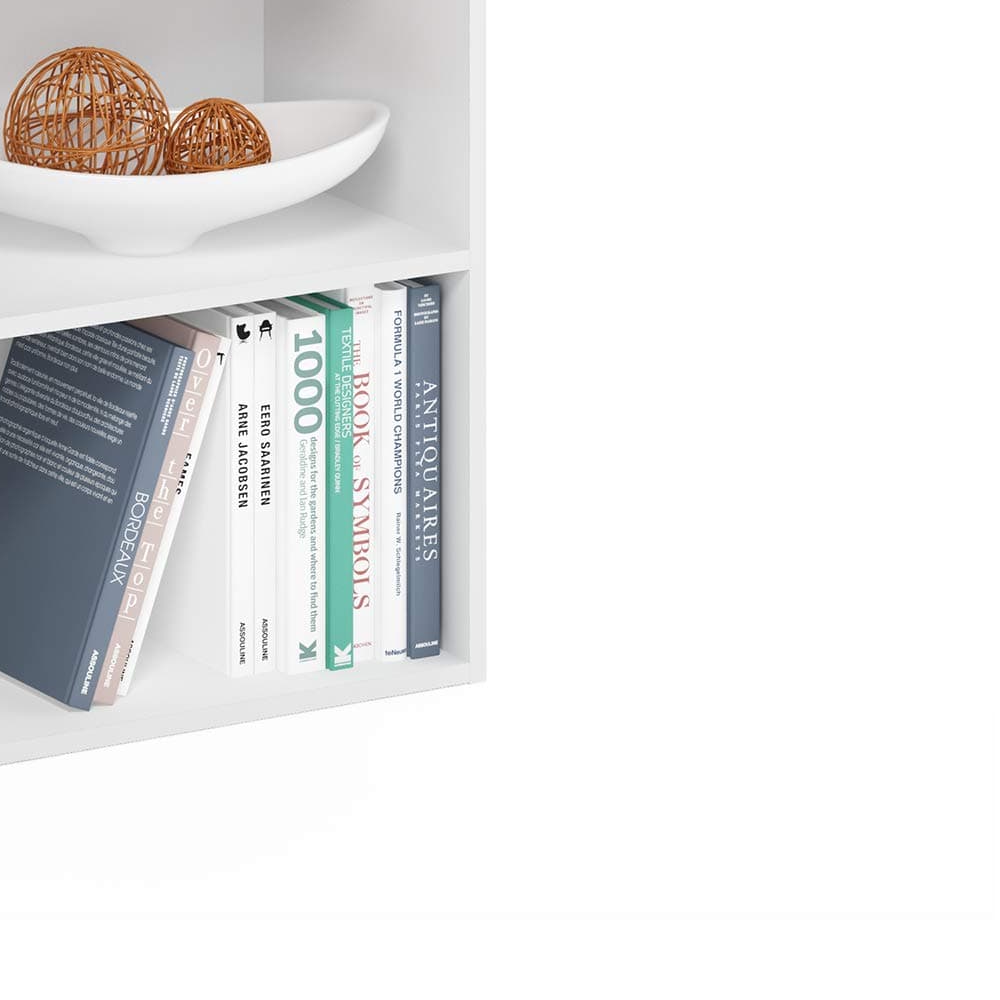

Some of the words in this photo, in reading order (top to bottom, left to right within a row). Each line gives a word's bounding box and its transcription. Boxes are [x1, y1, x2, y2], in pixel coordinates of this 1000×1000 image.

[342, 326, 352, 372] TEXTILE
[394, 310, 402, 367] FORMULA
[180, 348, 212, 432] Over
[294, 330, 322, 434] 1000
[334, 373, 340, 382] AT
[238, 404, 248, 436] ARNE
[260, 404, 270, 436] EERO
[342, 375, 352, 439] DESIGNERS
[353, 373, 370, 447] BOOK
[394, 379, 402, 422] WORLD
[260, 442, 270, 506] SAARINEN
[300, 439, 308, 478] Geraldine
[309, 436, 318, 469] designs
[353, 455, 360, 470] OF
[394, 424, 402, 494] CHAMPIONS
[421, 380, 438, 561] ANTIQUAIRES
[154, 459, 176, 520] the
[238, 442, 248, 508] JACOBSEN
[300, 480, 308, 495] and
[310, 471, 318, 482] for
[310, 484, 318, 498] the
[298, 512, 308, 538] Rudge
[308, 500, 318, 534] gardens
[110, 492, 150, 586] BORDEAUX
[353, 476, 370, 610] SYMBOLS
[310, 582, 317, 590] to
[310, 592, 318, 609] find
[310, 610, 318, 632] them
[81, 650, 99, 695] ASSOULINE
